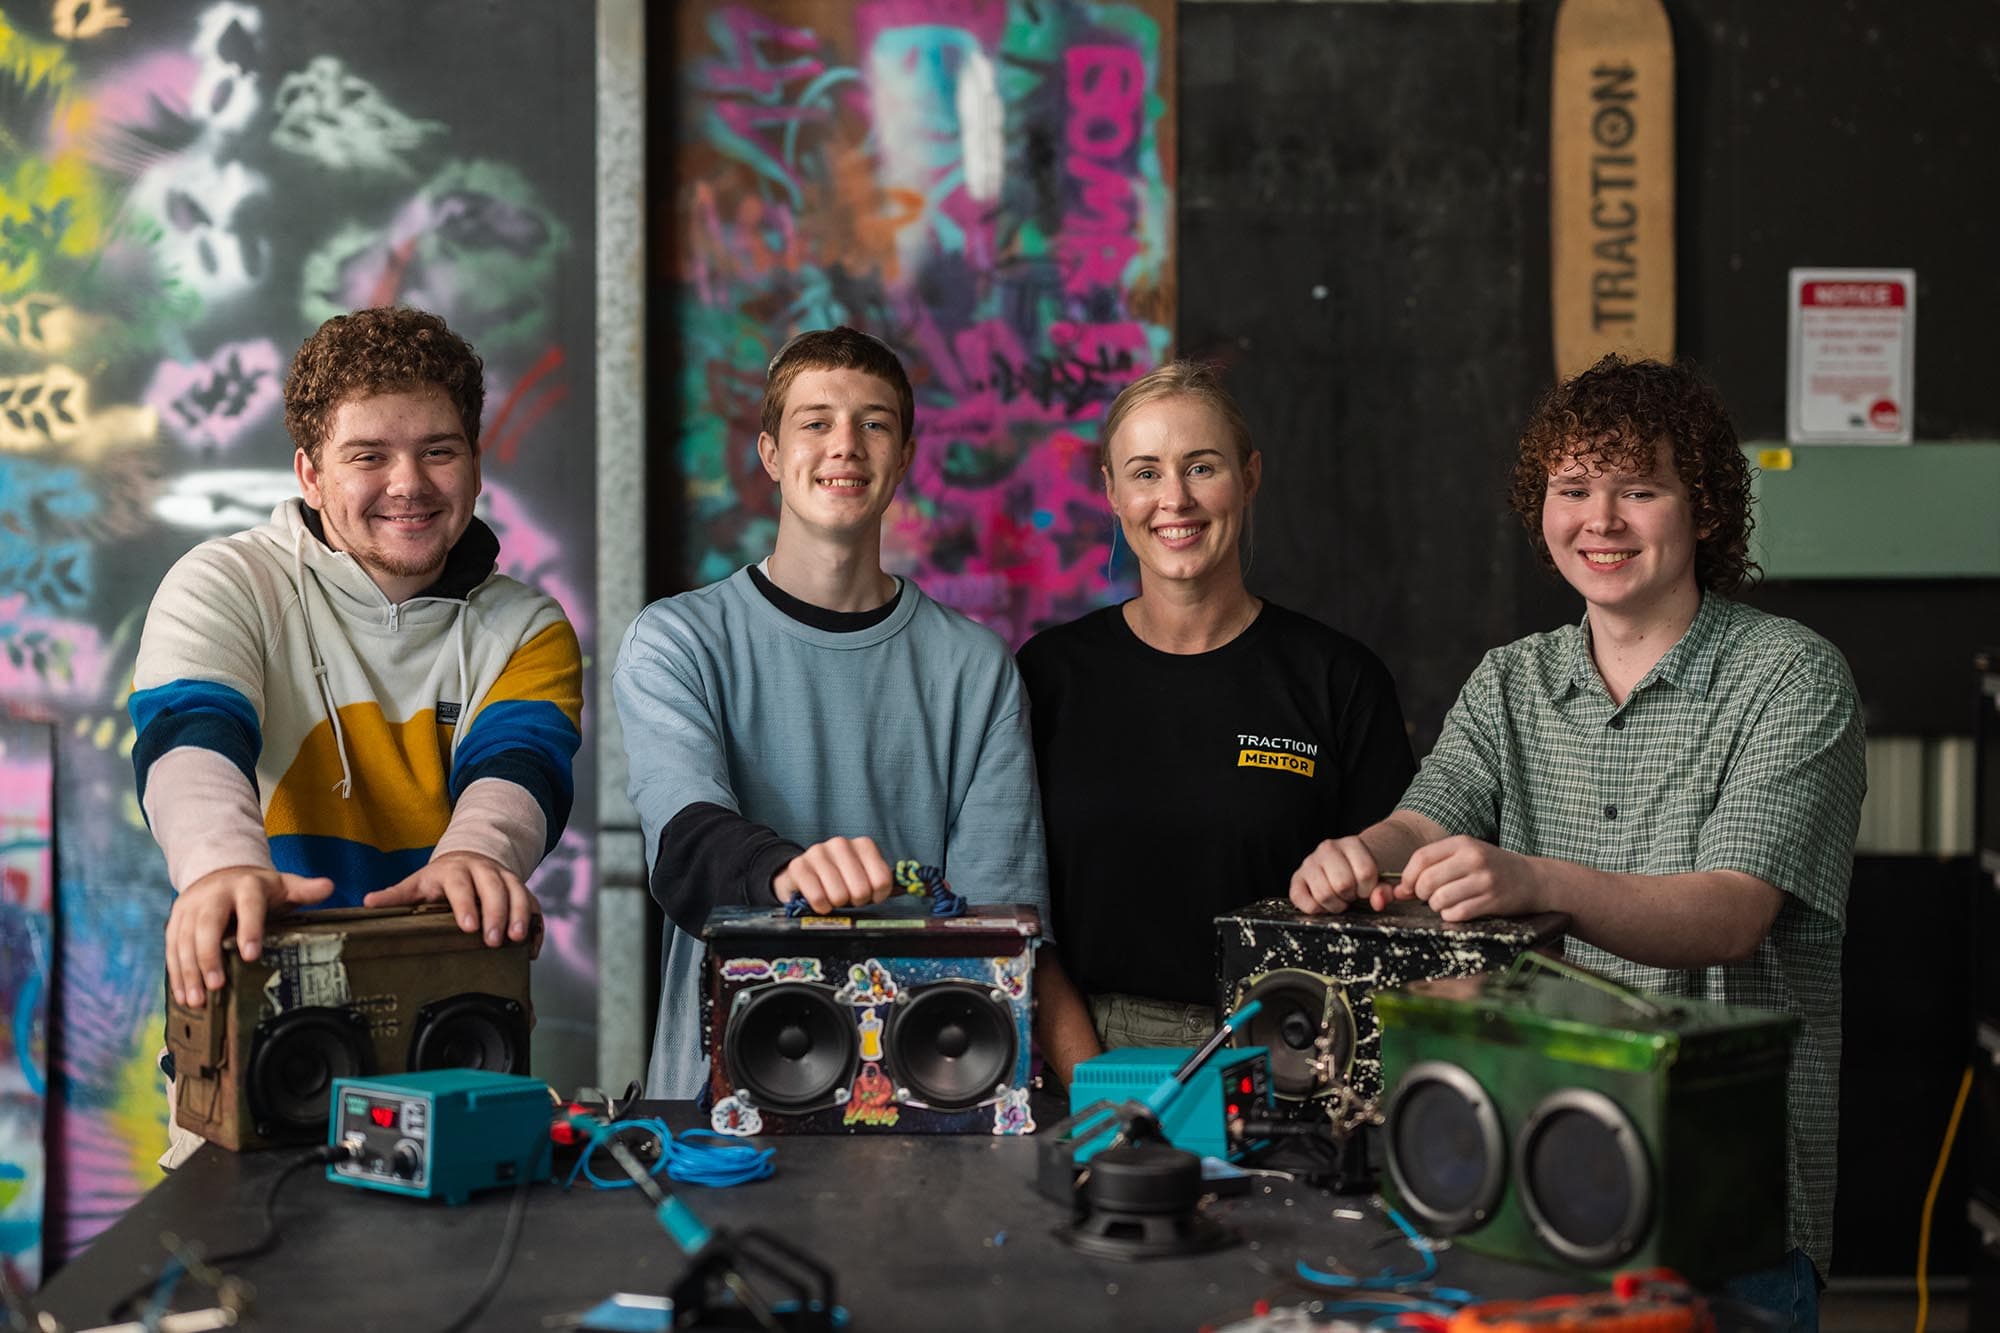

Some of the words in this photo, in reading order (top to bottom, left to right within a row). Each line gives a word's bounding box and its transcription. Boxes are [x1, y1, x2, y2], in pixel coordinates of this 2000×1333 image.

[1590, 62, 1638, 332] TRACTION
[1814, 284, 1892, 304] NOTICE
[1237, 734, 1318, 756] TRACTION
[1245, 754, 1309, 772] MENTOR
